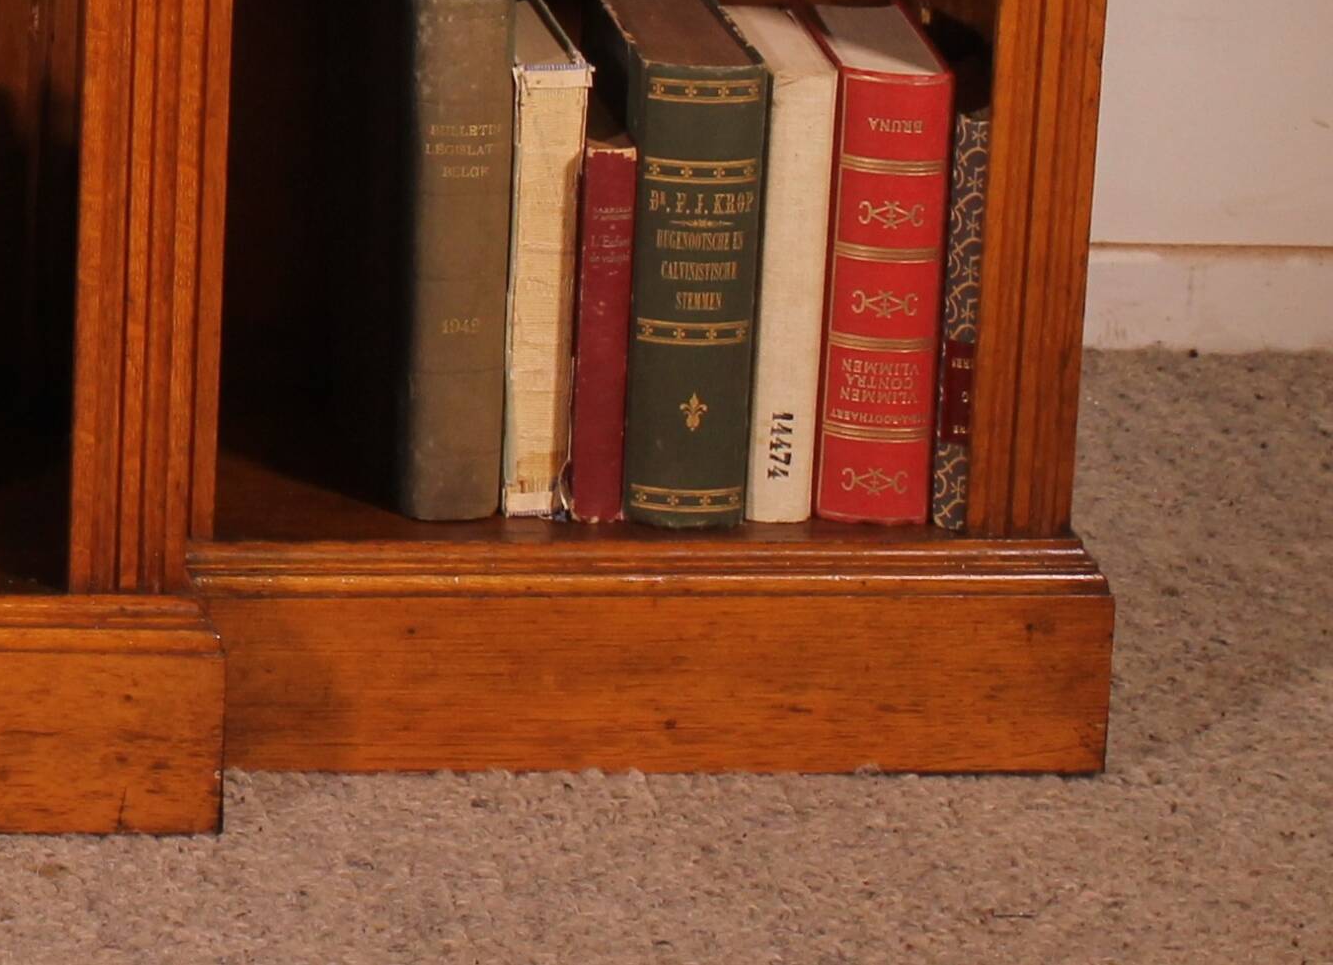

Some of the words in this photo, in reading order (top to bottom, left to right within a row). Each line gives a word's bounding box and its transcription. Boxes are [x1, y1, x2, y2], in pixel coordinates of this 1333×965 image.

[866, 117, 924, 134] BRUNA
[675, 192, 691, 214] P.
[713, 191, 755, 215] KROP
[675, 291, 724, 311] STEMMEN
[842, 358, 921, 377] VLIMMEN
[844, 372, 914, 391] CONTRA
[839, 386, 919, 406] VLIMMEN
[767, 412, 796, 480] 14474
